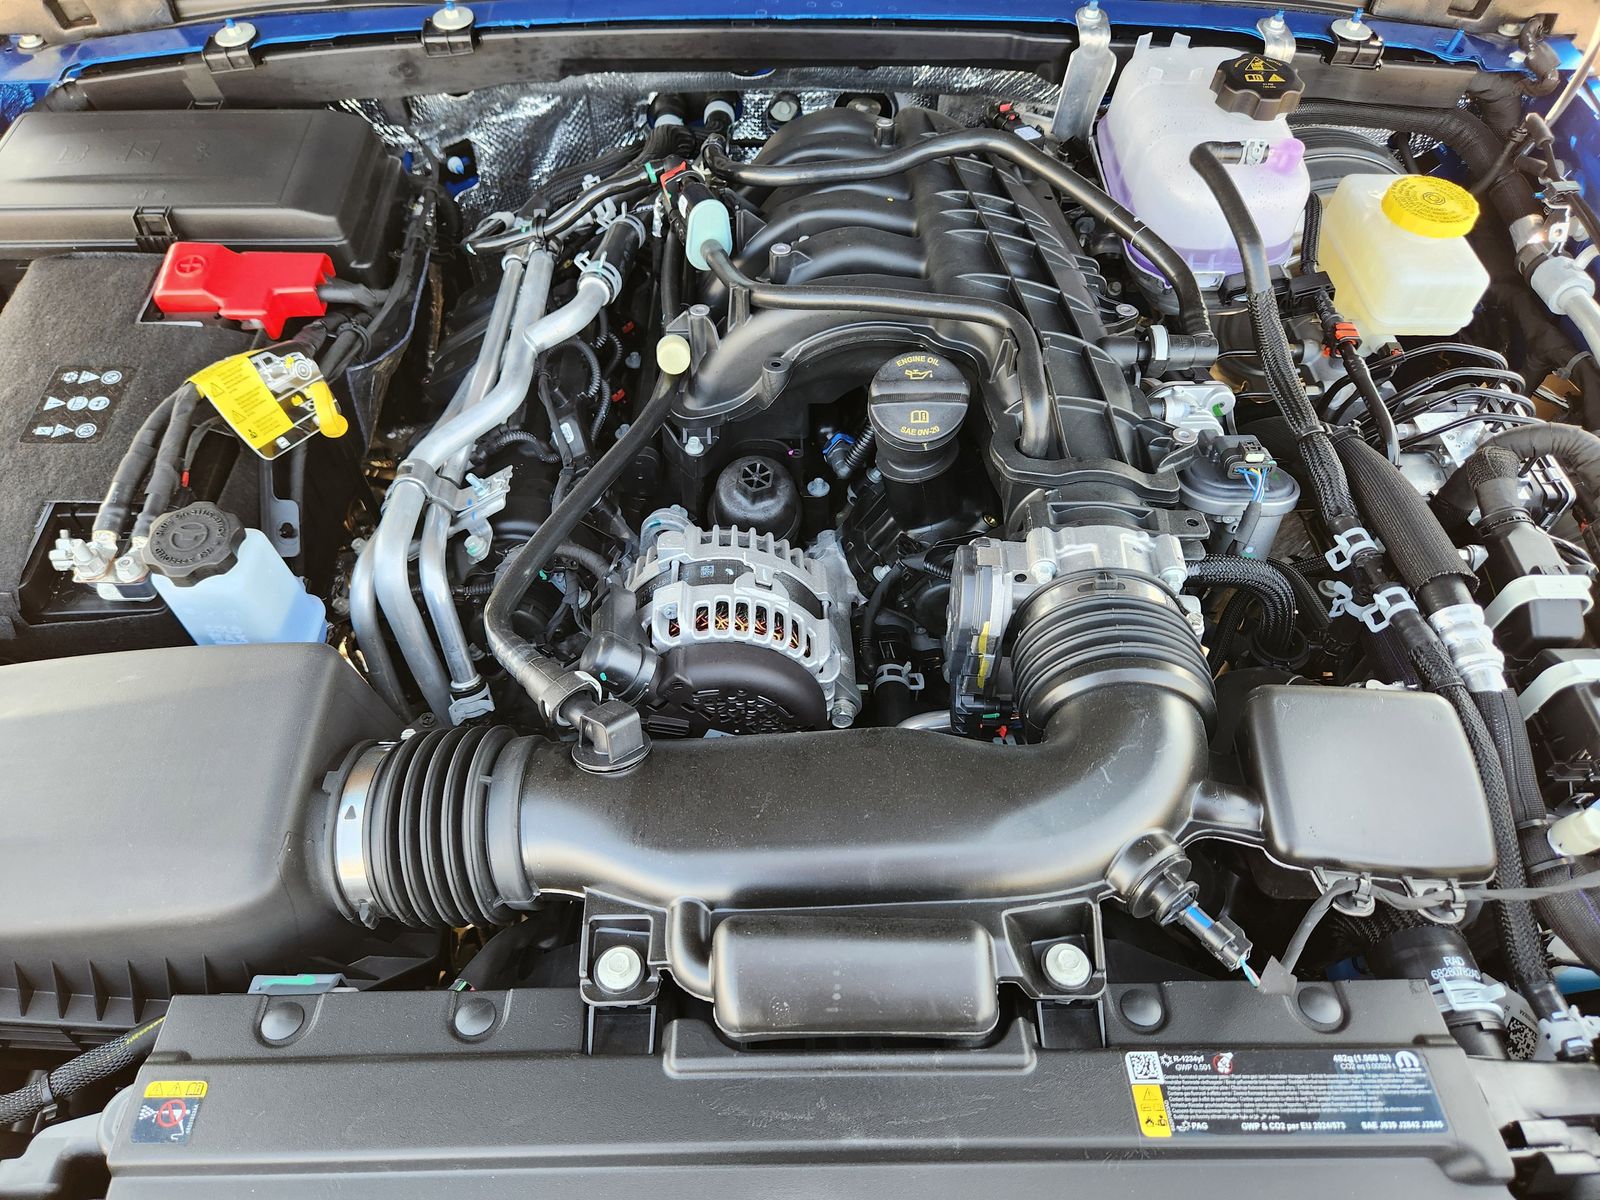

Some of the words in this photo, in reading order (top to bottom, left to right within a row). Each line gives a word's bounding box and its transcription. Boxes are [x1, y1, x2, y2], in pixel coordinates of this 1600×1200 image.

[896, 355, 926, 367] ENGINE
[927, 357, 940, 367] OIL
[900, 425, 917, 436] SAE
[917, 425, 940, 436] 0W-20
[1442, 956, 1466, 966] RAD
[1175, 1063, 1192, 1072] GWP
[1191, 1122, 1208, 1130] PAG
[1241, 1122, 1260, 1131] GWP
[1261, 1122, 1268, 1130] &
[1268, 1122, 1286, 1130] CO2
[1286, 1123, 1299, 1132] per
[1300, 1121, 1312, 1130] EU
[1361, 1121, 1379, 1129] SAE
